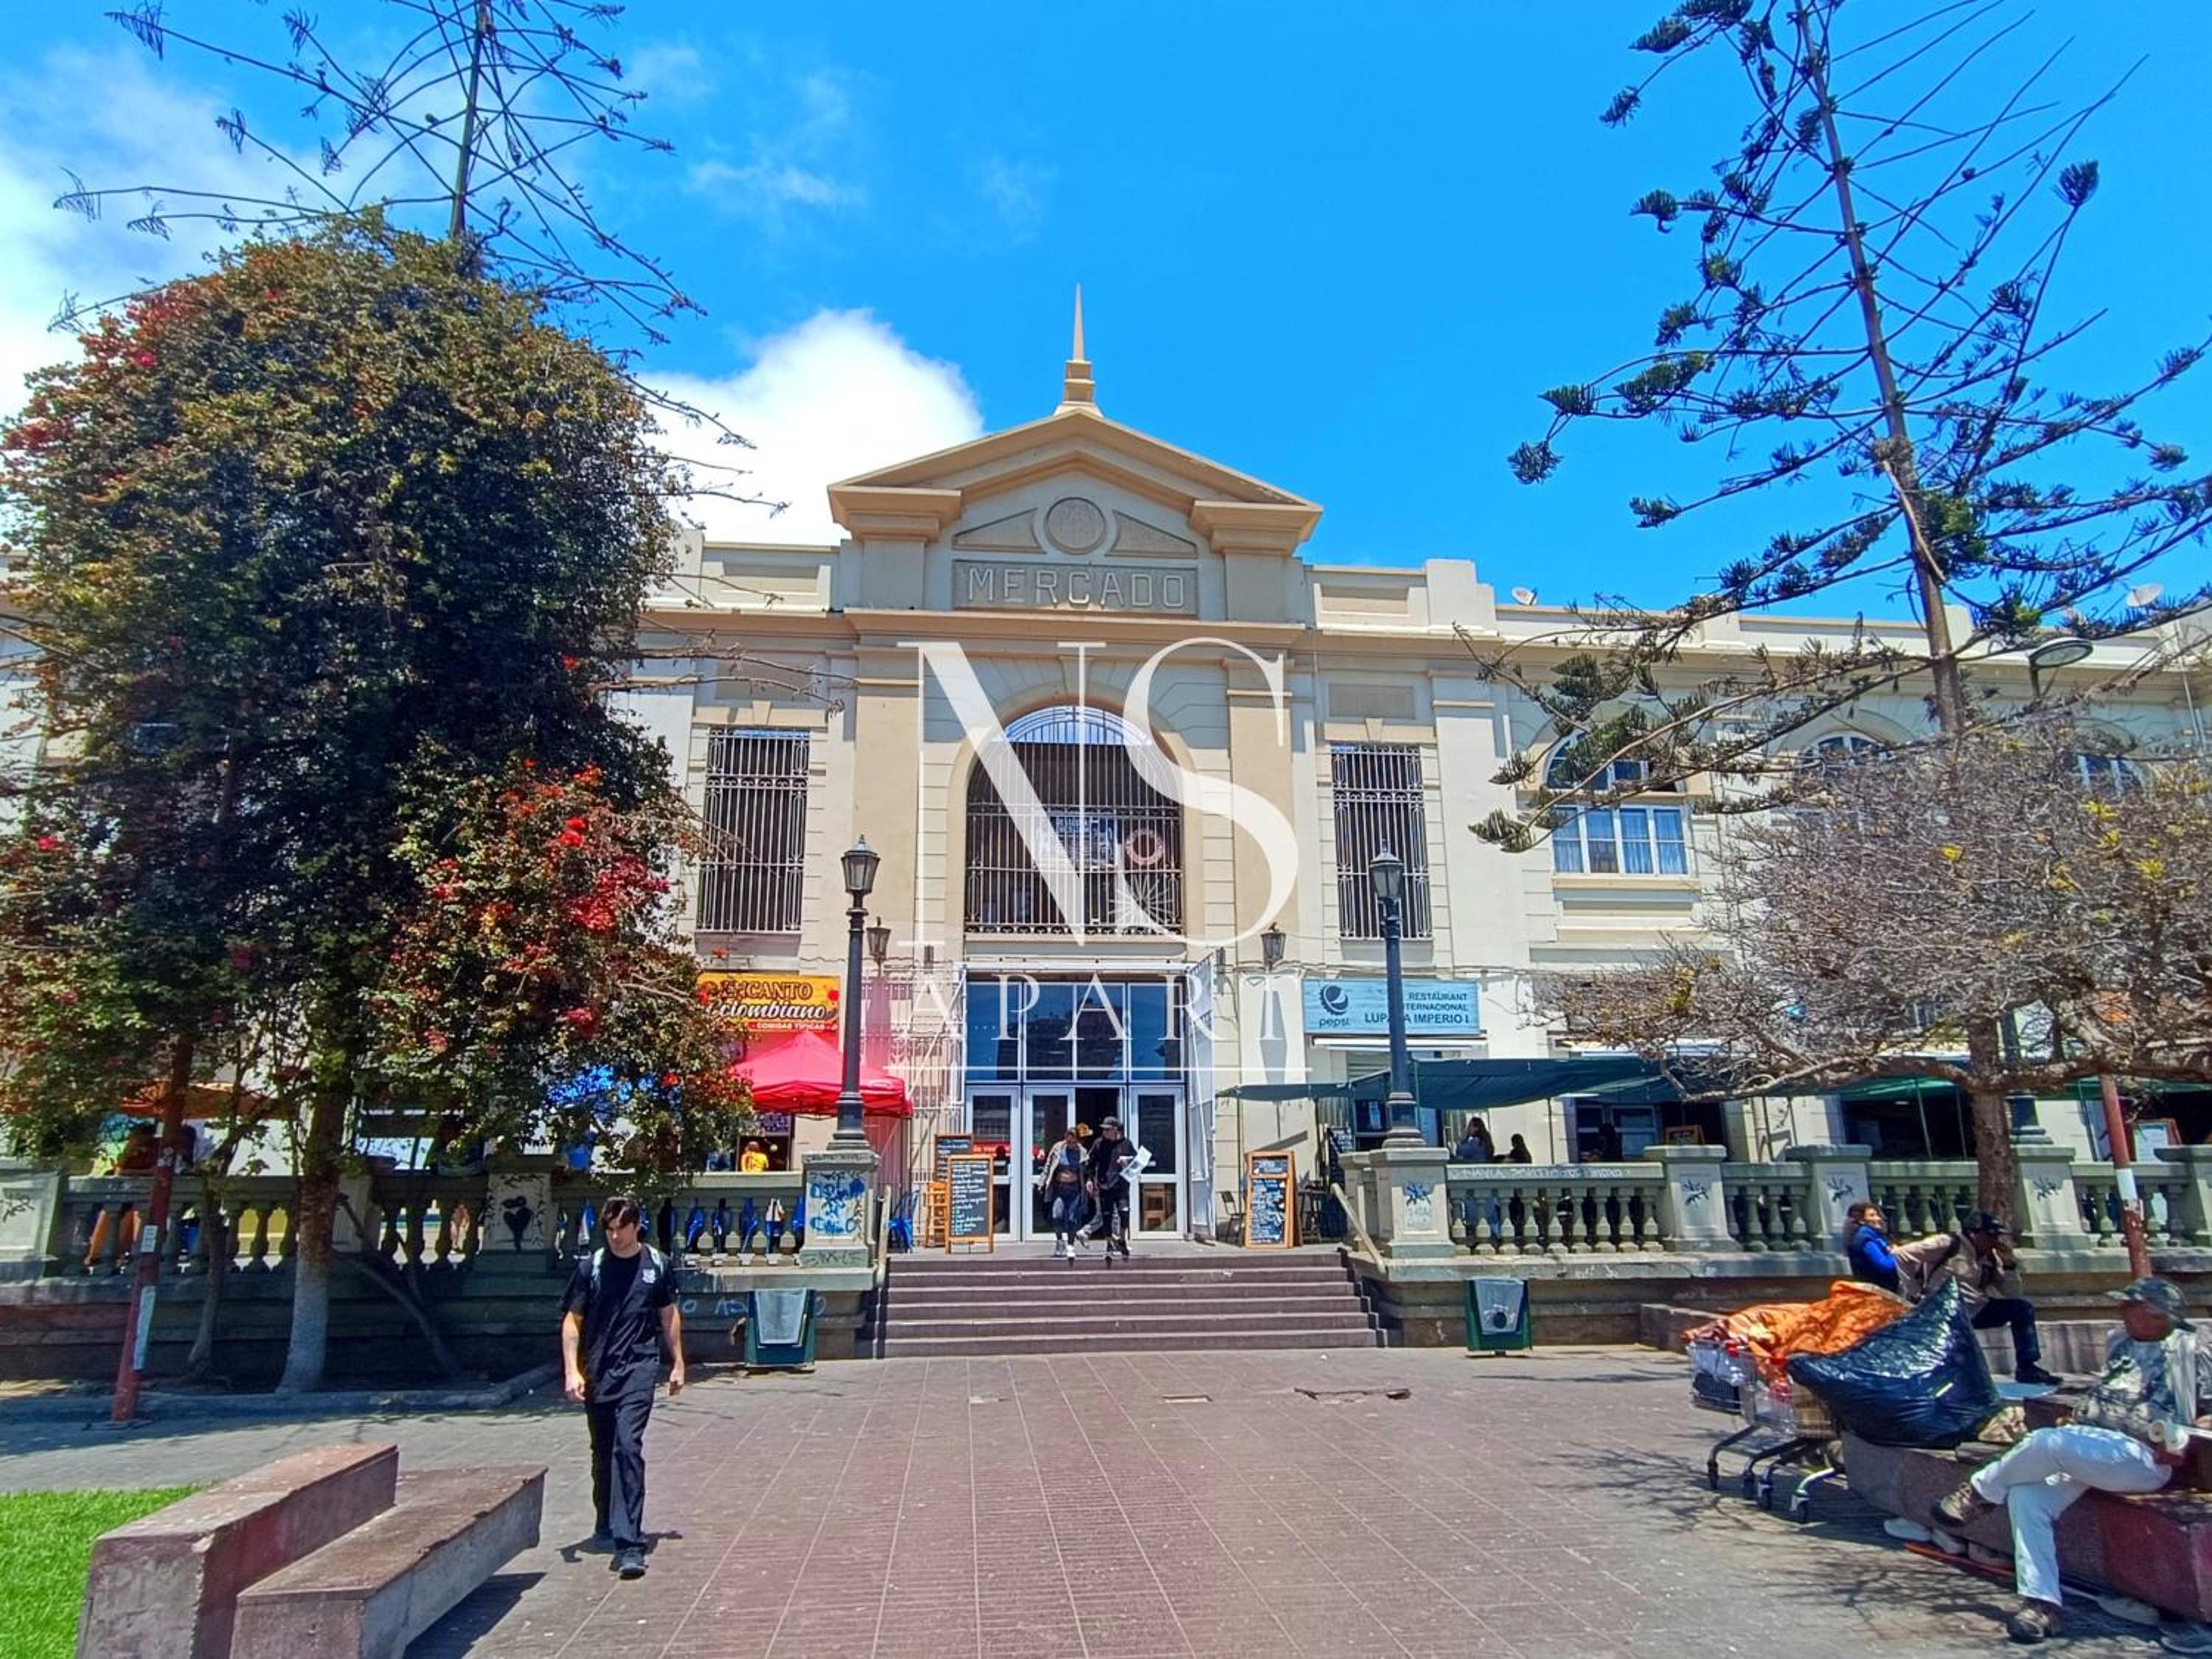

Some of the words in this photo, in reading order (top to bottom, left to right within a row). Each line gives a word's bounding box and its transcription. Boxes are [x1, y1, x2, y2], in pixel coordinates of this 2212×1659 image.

[968, 567, 1184, 608] MERCADO
[1408, 992, 1467, 1001] RESTAURANT
[1404, 1002, 1469, 1011] TERNACIONAL
[1319, 1018, 1350, 1028] pepsi
[1413, 1013, 1463, 1023] IMPERIO
